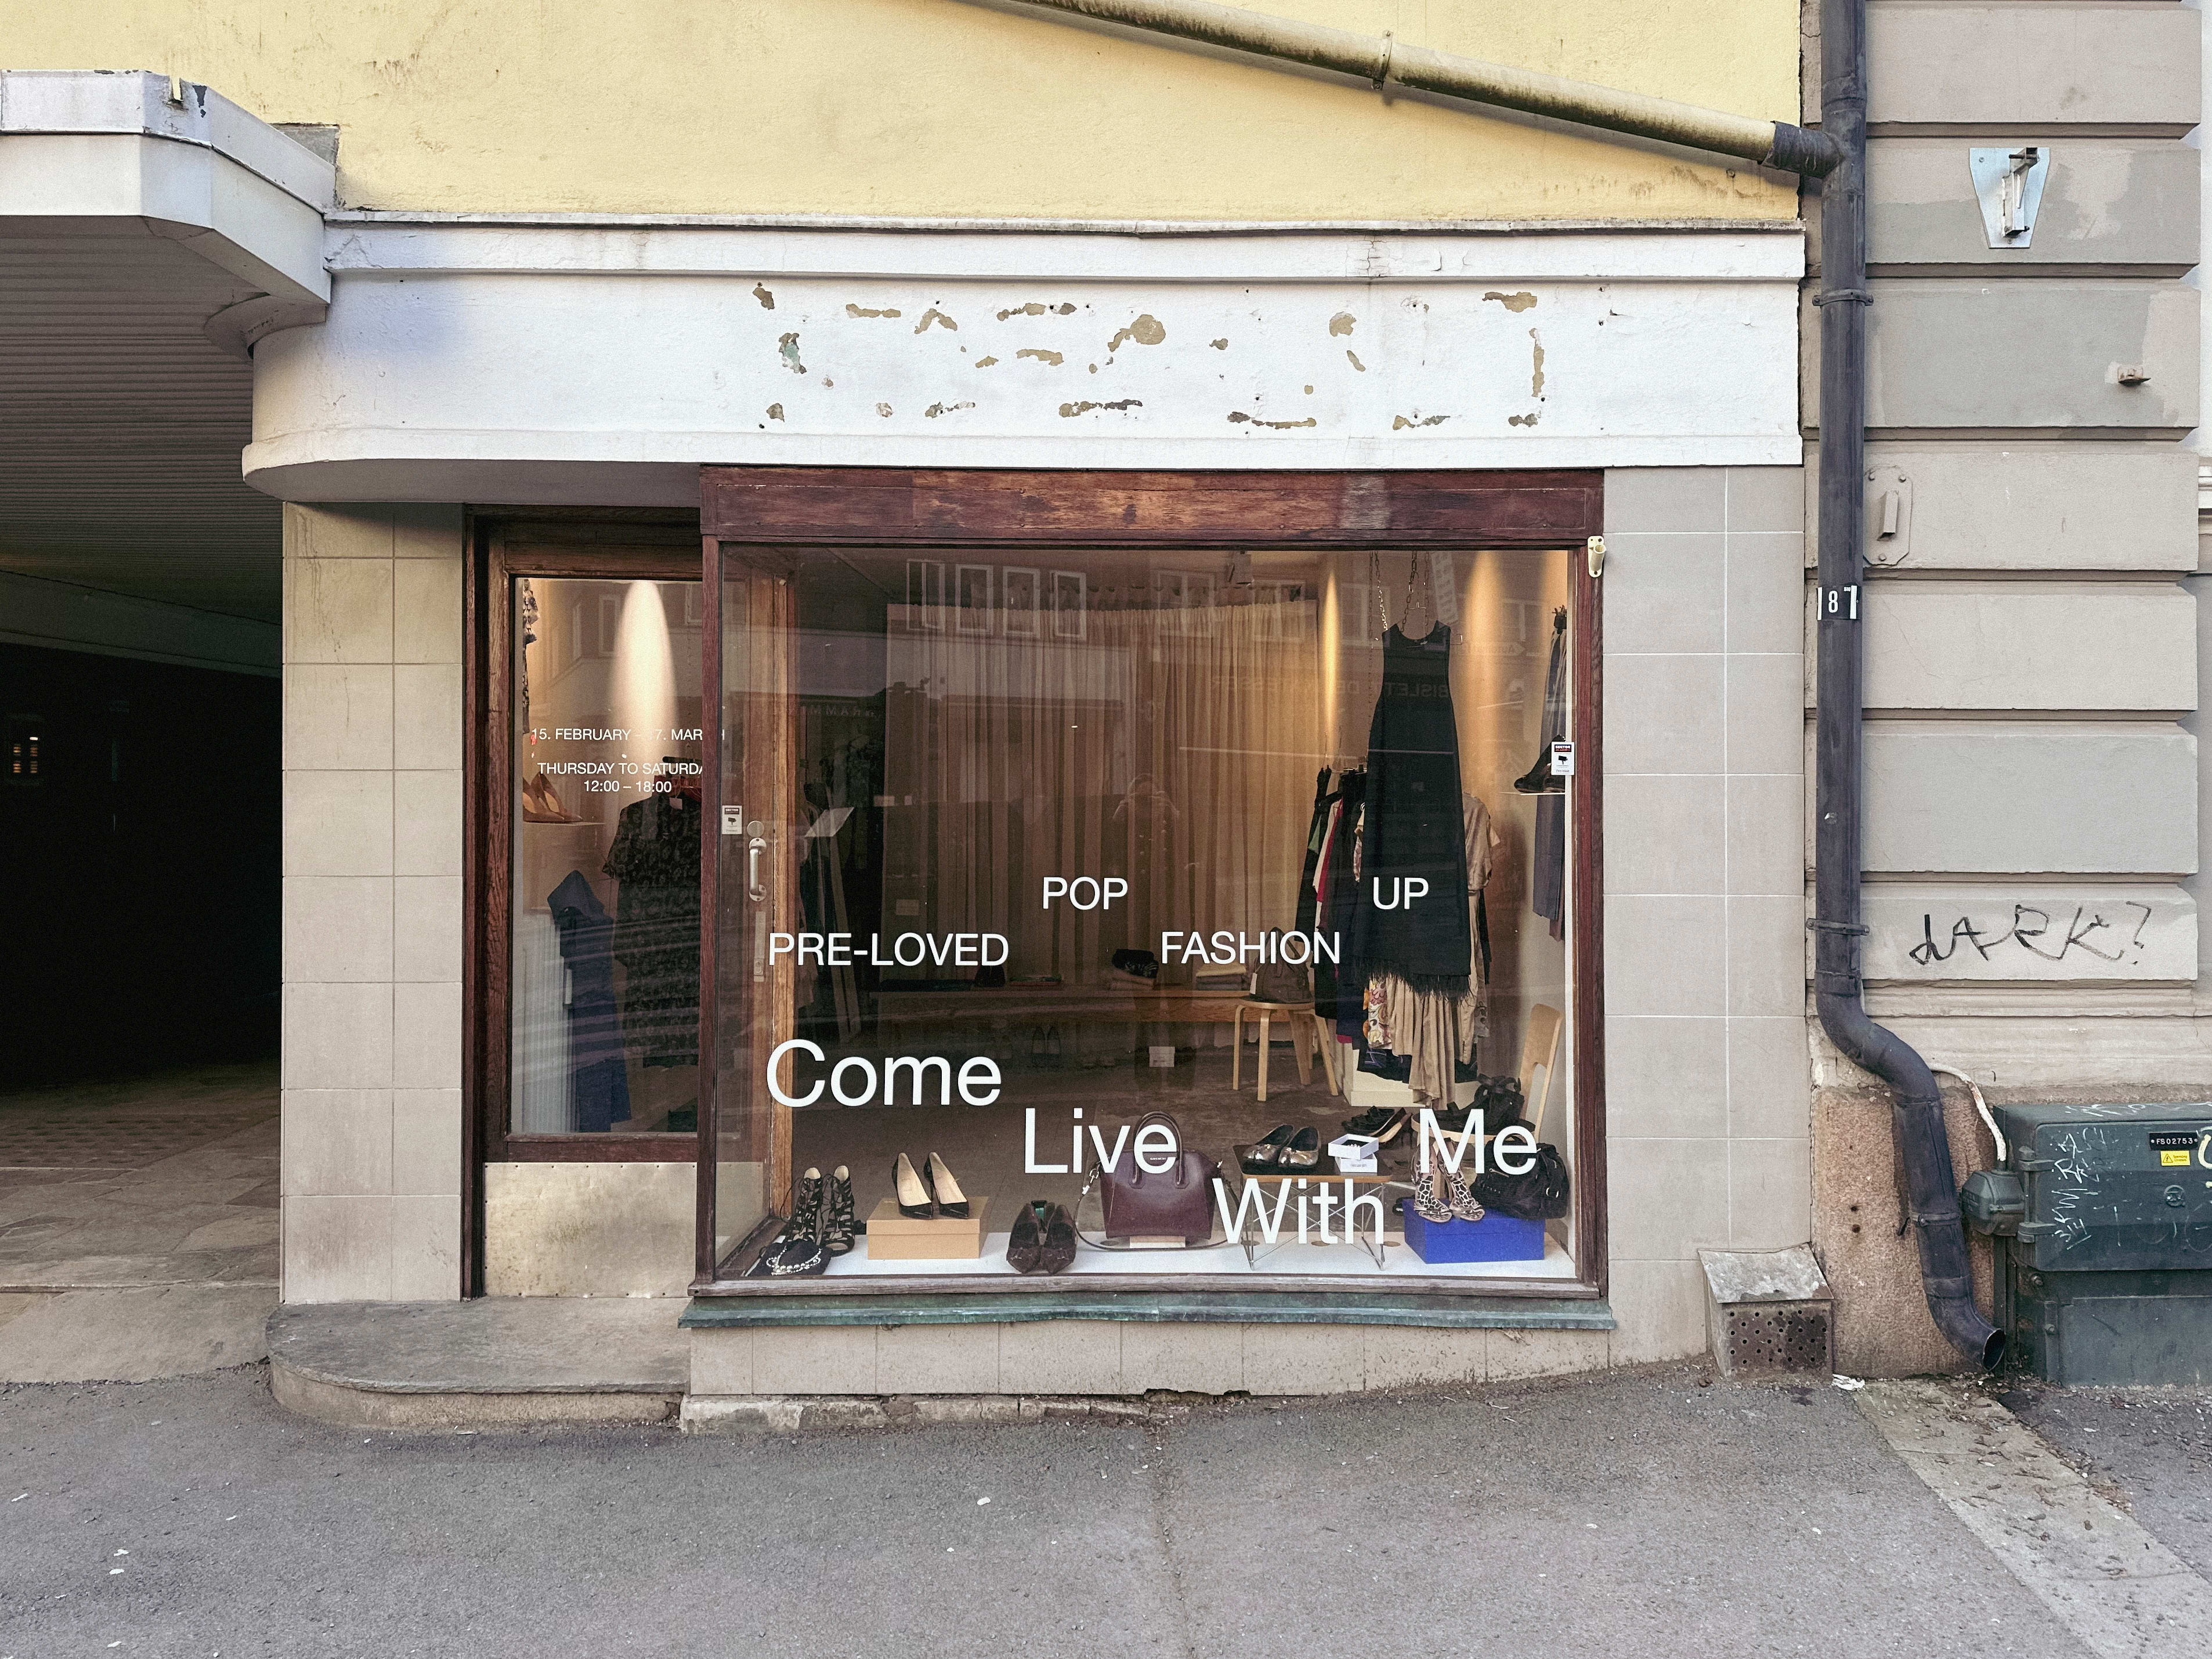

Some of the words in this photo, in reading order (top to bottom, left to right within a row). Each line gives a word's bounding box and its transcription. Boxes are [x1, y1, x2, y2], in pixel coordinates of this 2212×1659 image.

[531, 728, 551, 740] 15.
[555, 728, 631, 740] FEBRUARY
[537, 762, 615, 775] THURSDAY
[618, 762, 638, 775] TO
[642, 762, 703, 775] SATURD
[584, 780, 620, 792] 12:00
[635, 780, 672, 793] 18:00
[1043, 876, 1128, 910] POP
[1372, 877, 1429, 910] UP
[769, 932, 1009, 966] PRE-LOVED
[1161, 931, 1340, 964] FASHION
[766, 1039, 1002, 1107] Come
[1024, 1108, 1178, 1175] Live
[1419, 1108, 1537, 1175] Me
[1212, 1178, 1384, 1245] With
